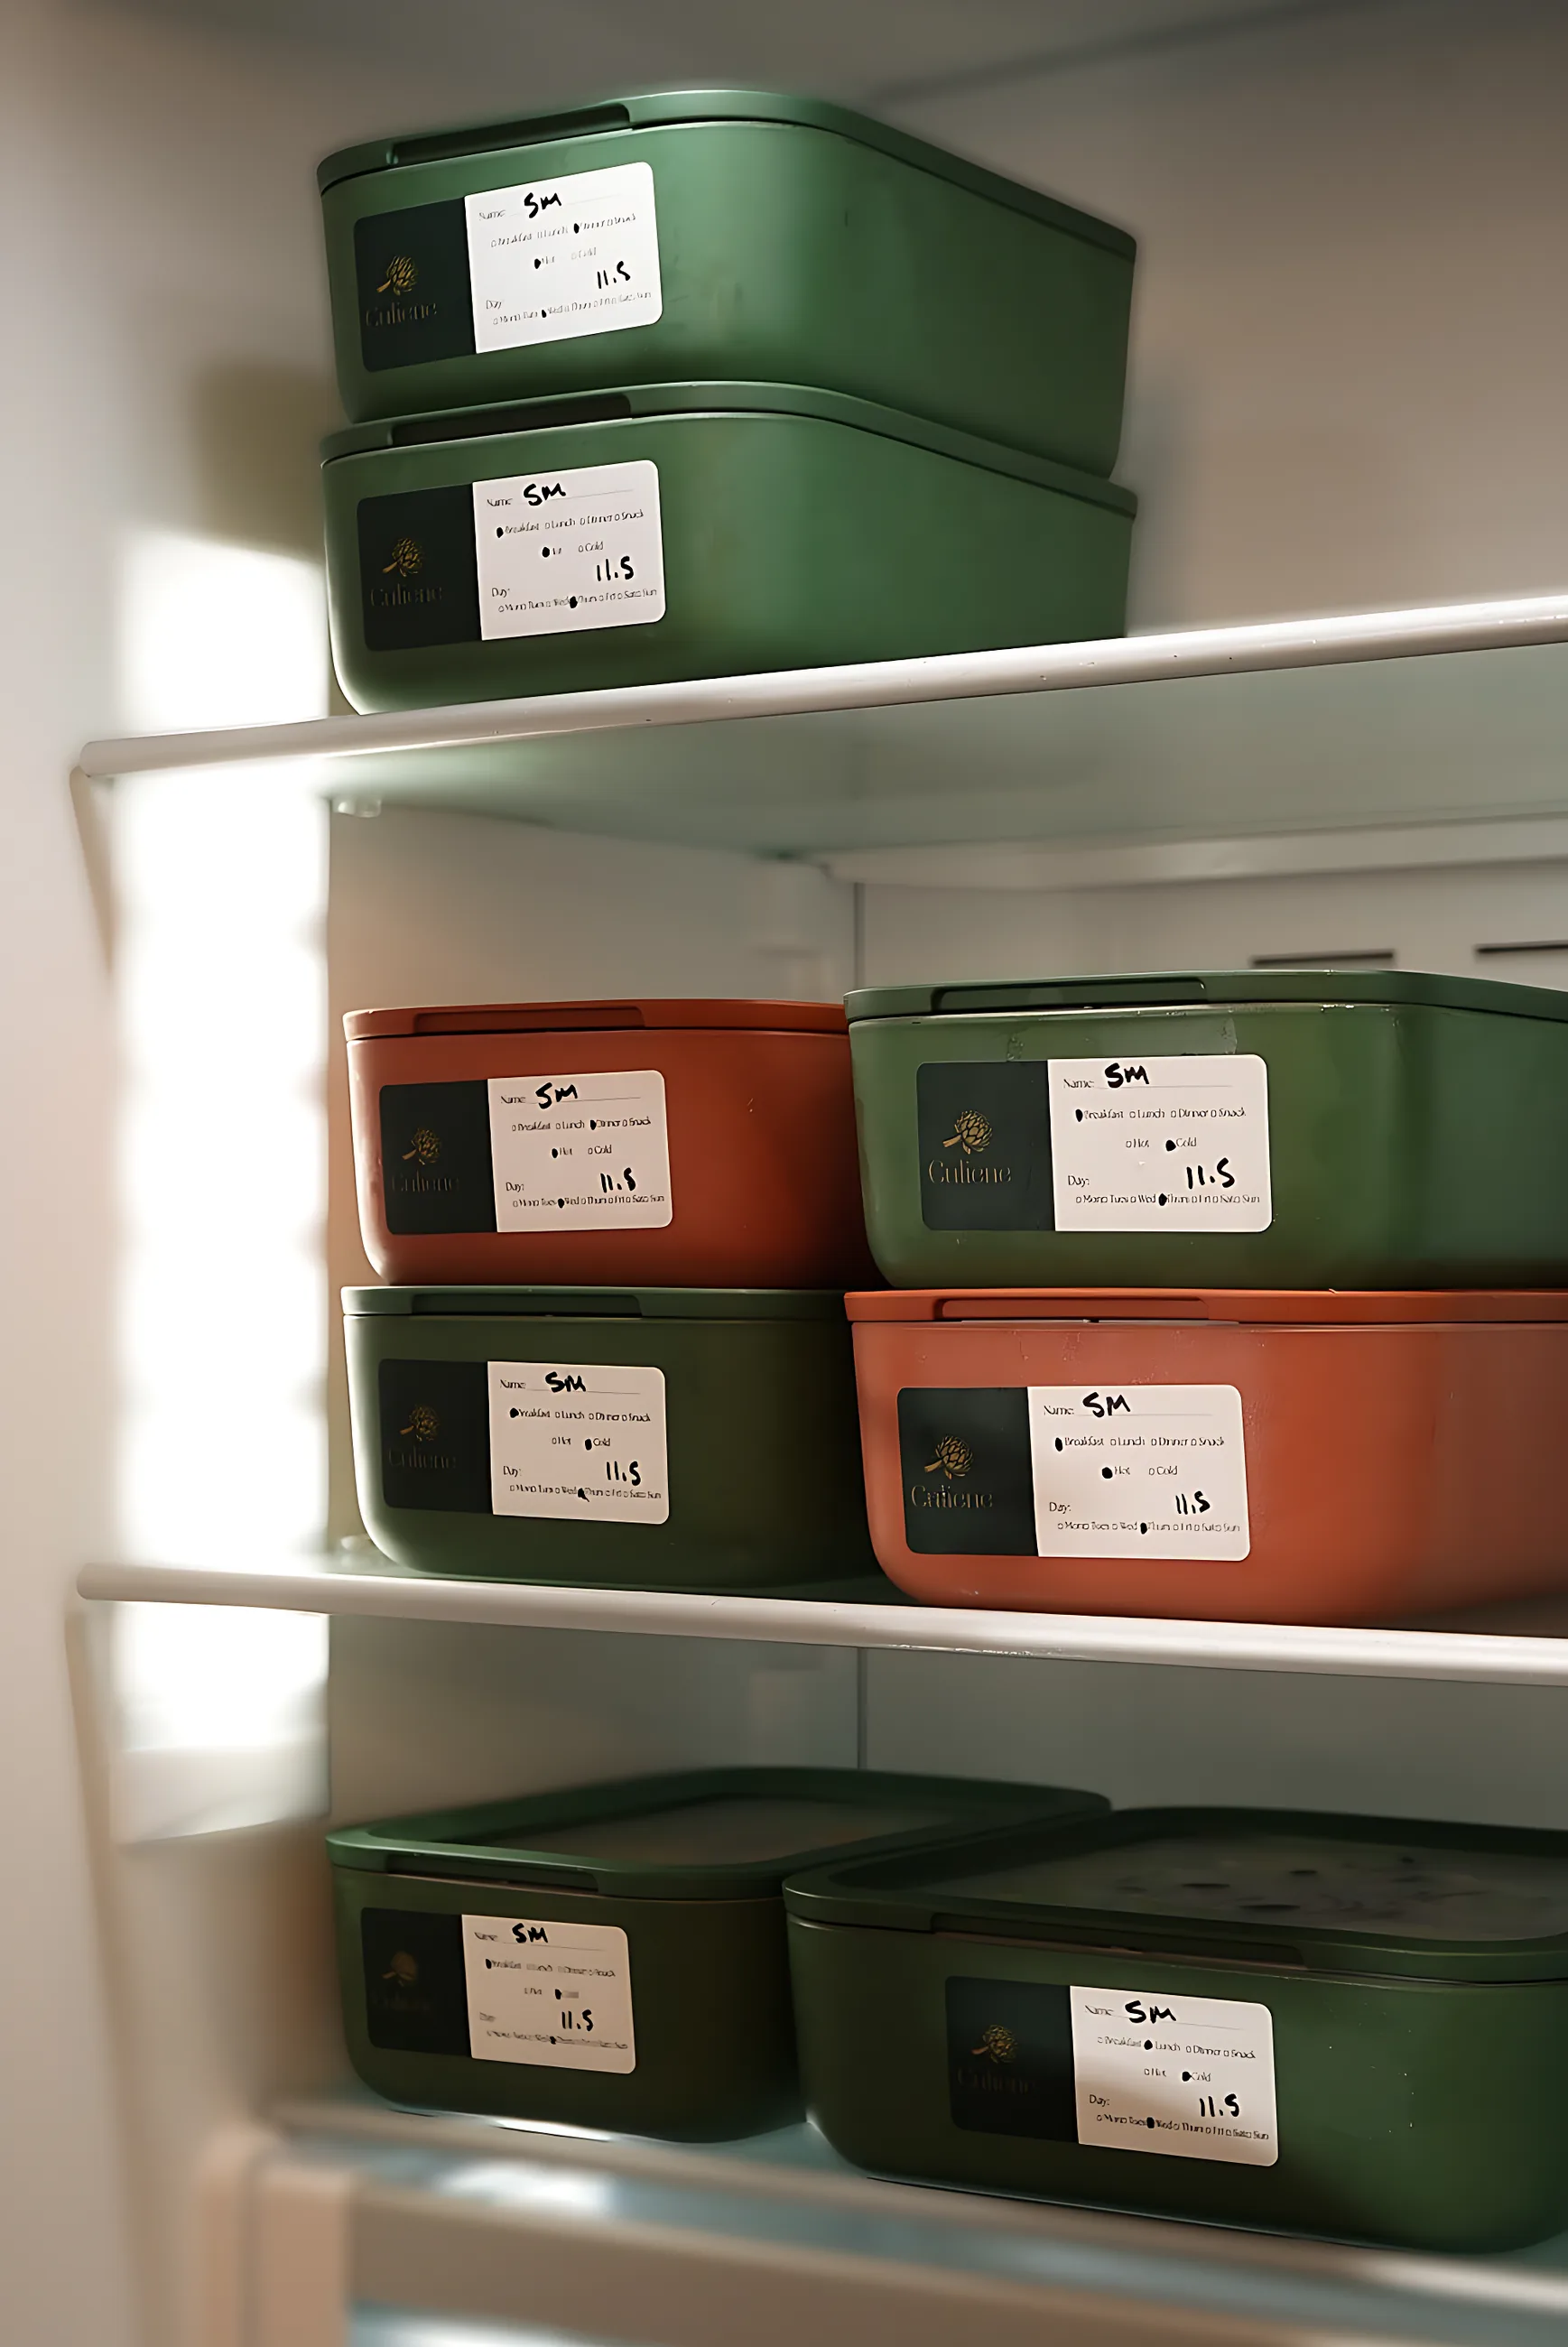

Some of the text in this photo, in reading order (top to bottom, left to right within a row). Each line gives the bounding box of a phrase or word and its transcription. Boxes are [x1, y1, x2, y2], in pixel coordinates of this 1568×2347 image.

[524, 192, 561, 218] SM
[597, 261, 630, 289] 11.5
[524, 483, 566, 506] SM
[597, 555, 634, 581] 11.5
[1105, 1062, 1149, 1089] SM
[535, 1082, 578, 1109] SM
[1176, 1137, 1197, 1147] Cold
[600, 1167, 636, 1192] 11.5
[1186, 1157, 1235, 1189] 11.5
[545, 1371, 587, 1393] SM
[1082, 1392, 1131, 1417] SM
[607, 1461, 641, 1486] 11.5
[1157, 1466, 1178, 1475] Cold
[1175, 1490, 1211, 1515] 11.5
[512, 1923, 548, 1943] SM
[561, 2009, 593, 2031] 11.5
[1125, 2000, 1176, 2024] SM
[1200, 2093, 1239, 2117] 11.5
